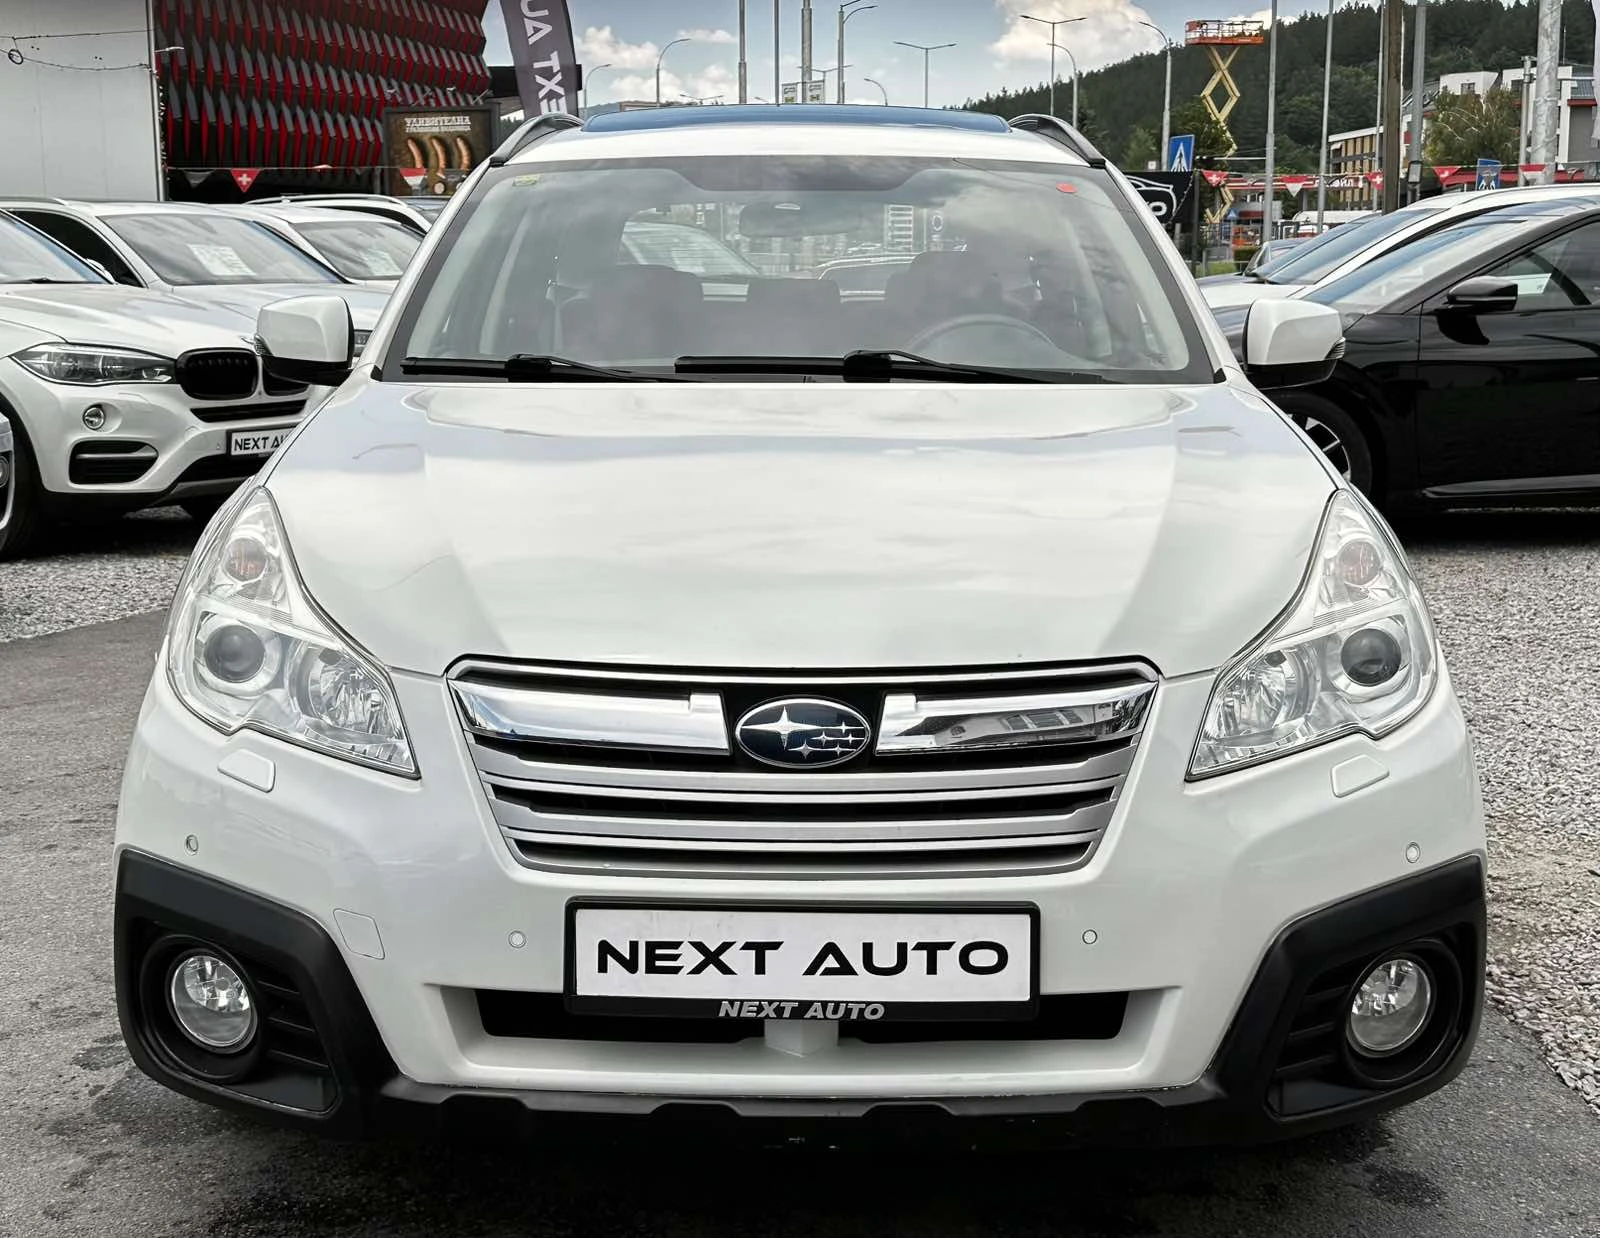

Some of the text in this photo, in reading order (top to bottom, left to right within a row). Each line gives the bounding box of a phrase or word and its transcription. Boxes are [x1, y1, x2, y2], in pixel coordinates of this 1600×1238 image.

[234, 436, 269, 451] NEXT
[597, 939, 1010, 976] NEXT AUTO
[718, 1000, 886, 1020] NEXT AUTO
